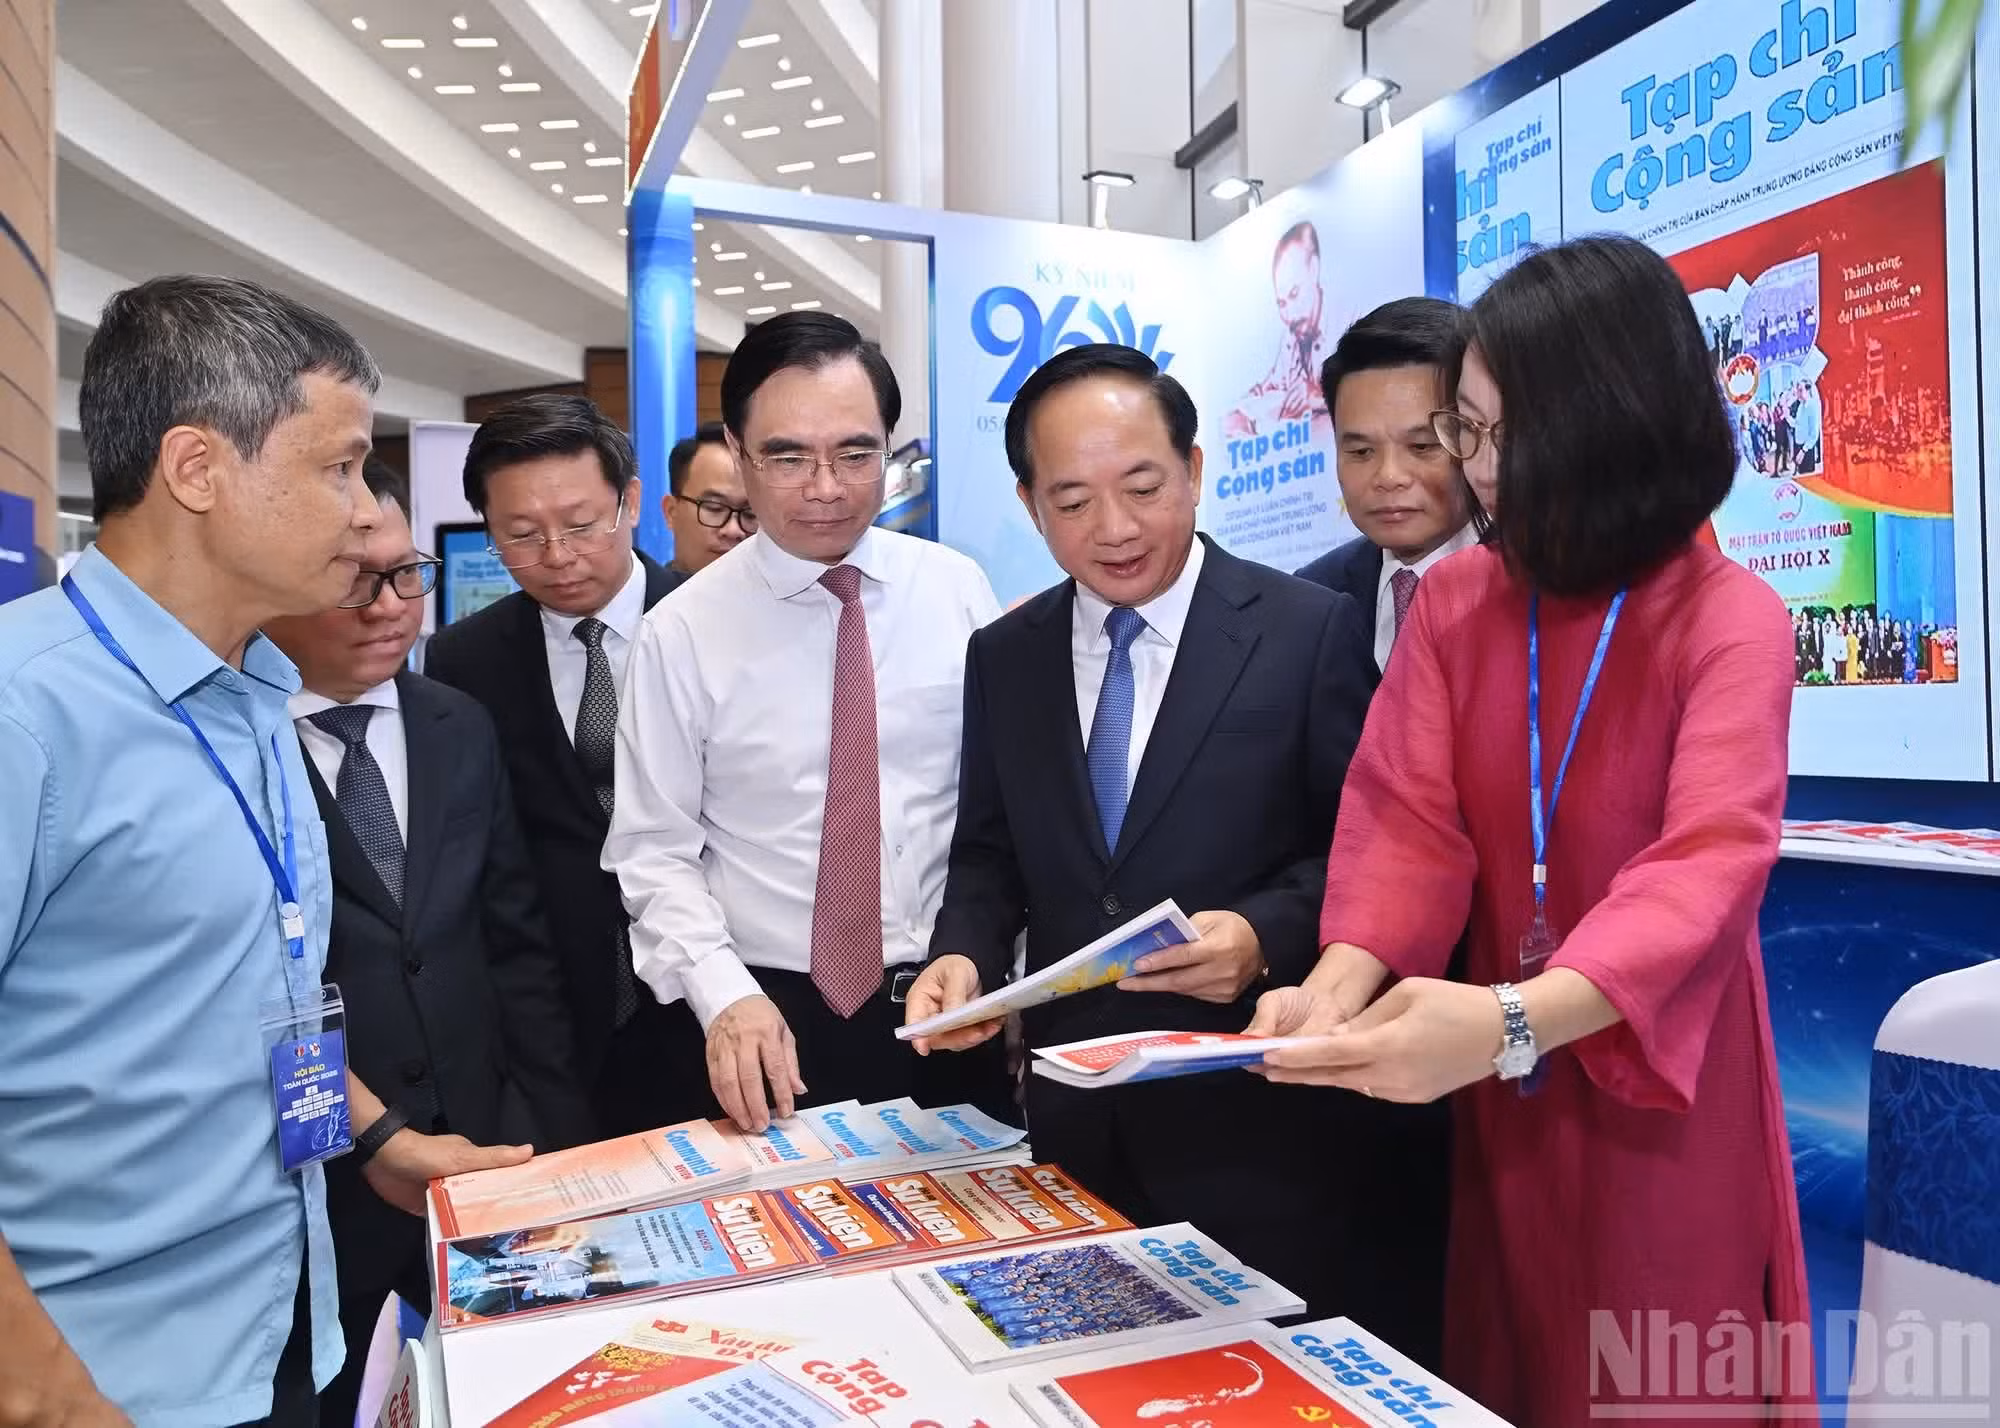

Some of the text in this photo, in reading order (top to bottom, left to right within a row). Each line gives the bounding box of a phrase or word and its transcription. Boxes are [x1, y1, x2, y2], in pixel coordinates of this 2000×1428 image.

[1621, 53, 1738, 141] Tạp
[1591, 40, 1905, 214] Cộng sản
[1227, 412, 1311, 470] Tạp chí
[1216, 449, 1325, 501] Cộng sản
[1748, 548, 1831, 575] ĐẠI HỘI X
[664, 1129, 720, 1177] Communist
[762, 1122, 809, 1161] mmunist
[822, 1111, 880, 1157] Communist
[1139, 1238, 1198, 1278] Cộng
[1189, 1277, 1241, 1306] sản
[1173, 1239, 1217, 1270] Tạp
[1211, 1269, 1261, 1292] chí
[846, 1358, 908, 1399] Tạp
[1290, 1334, 1373, 1387] Cộng
[1333, 1337, 1456, 1410] Tạp chí
[801, 1360, 887, 1416] Cộng
